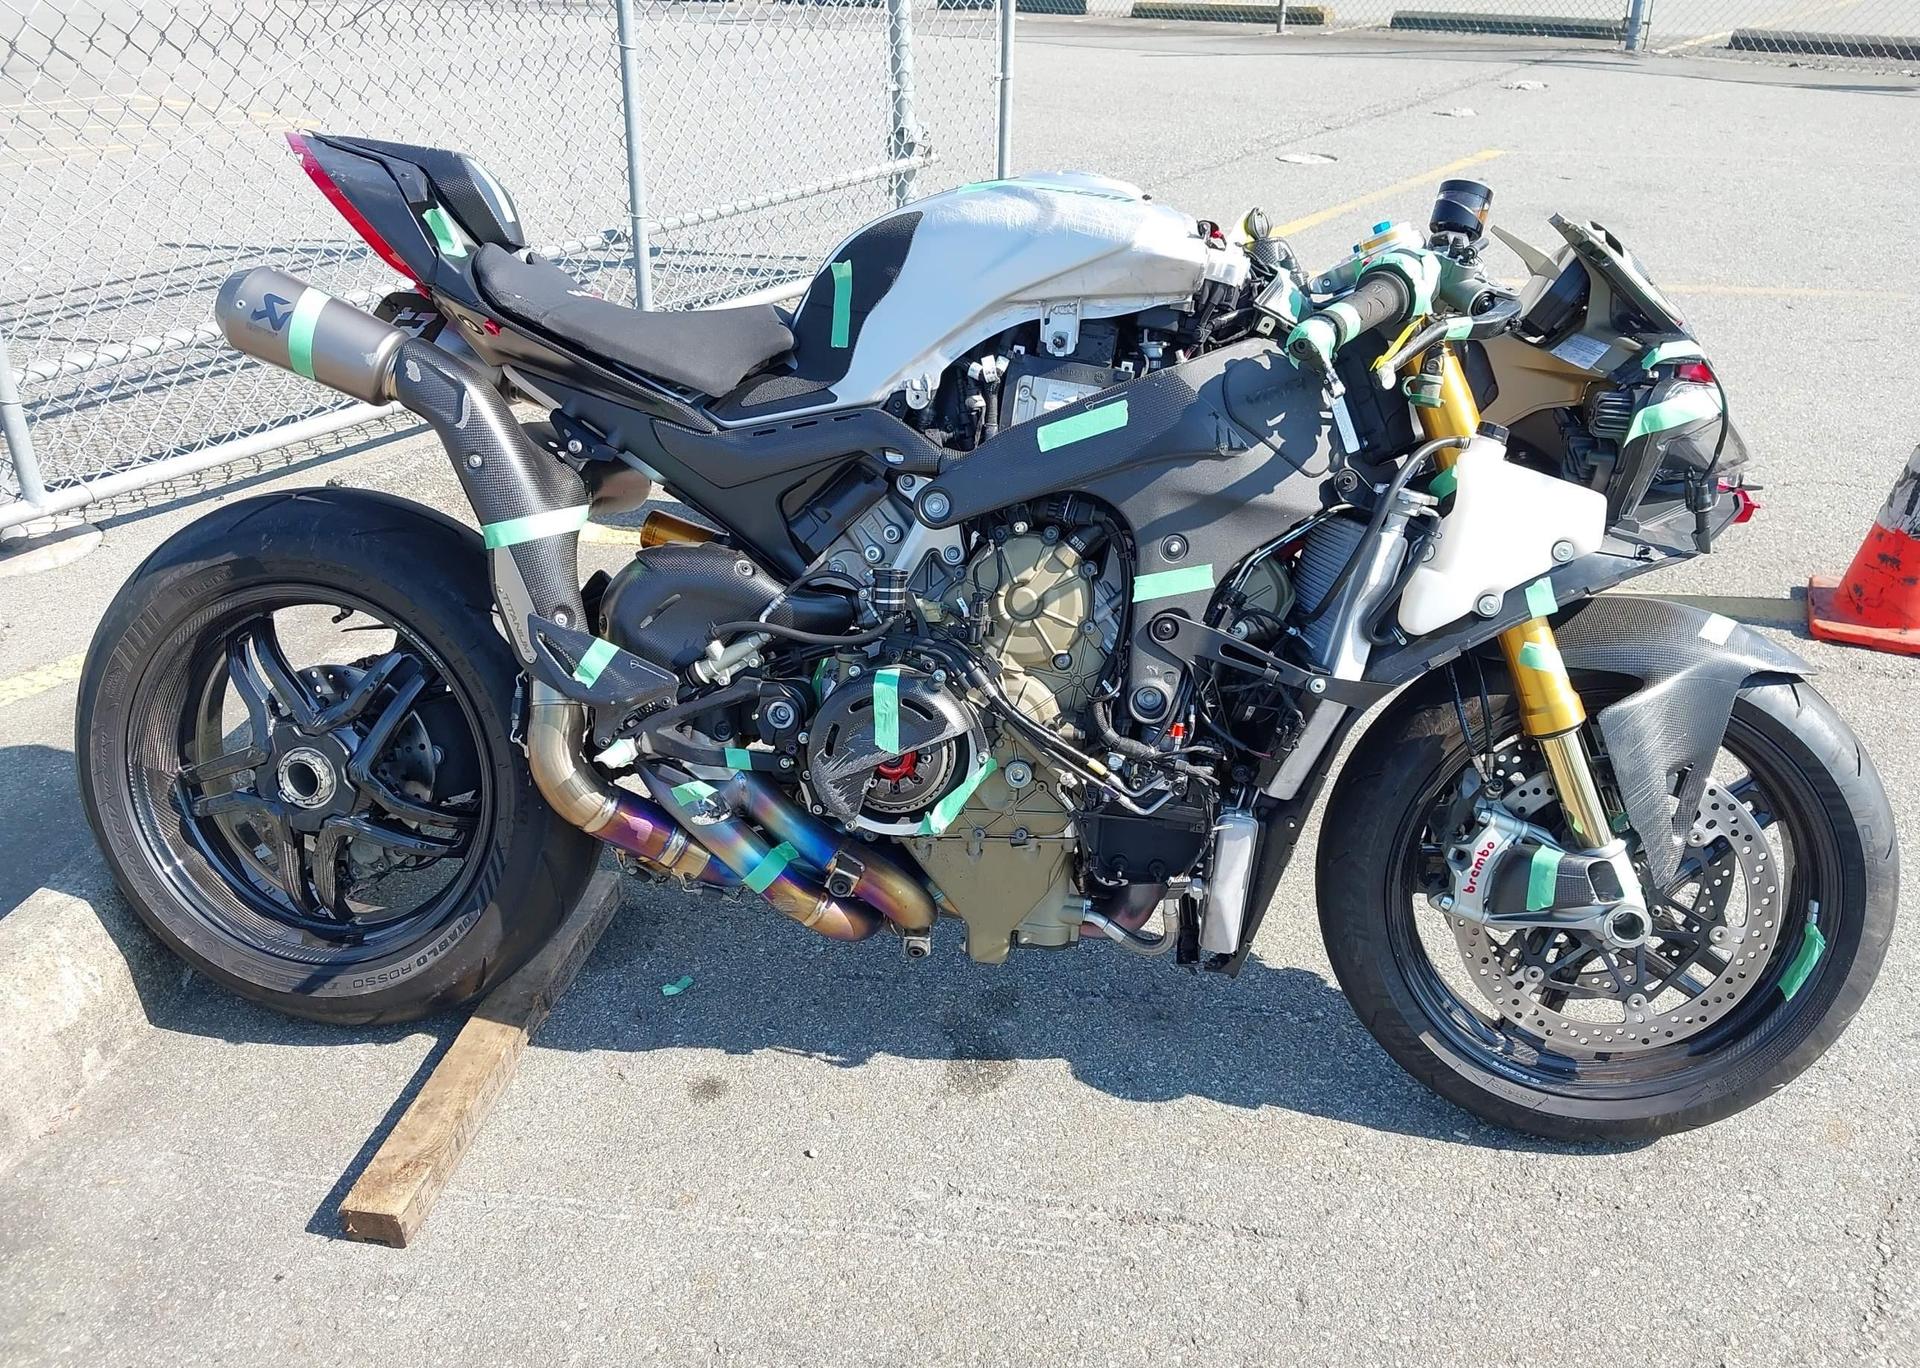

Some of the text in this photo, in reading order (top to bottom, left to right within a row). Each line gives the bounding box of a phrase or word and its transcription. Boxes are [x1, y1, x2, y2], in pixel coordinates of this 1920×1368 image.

[503, 593, 531, 654] TITANIUM
[1463, 841, 1495, 893] brembo
[416, 915, 473, 966] DIABLO
[352, 962, 412, 989] ROSSO
